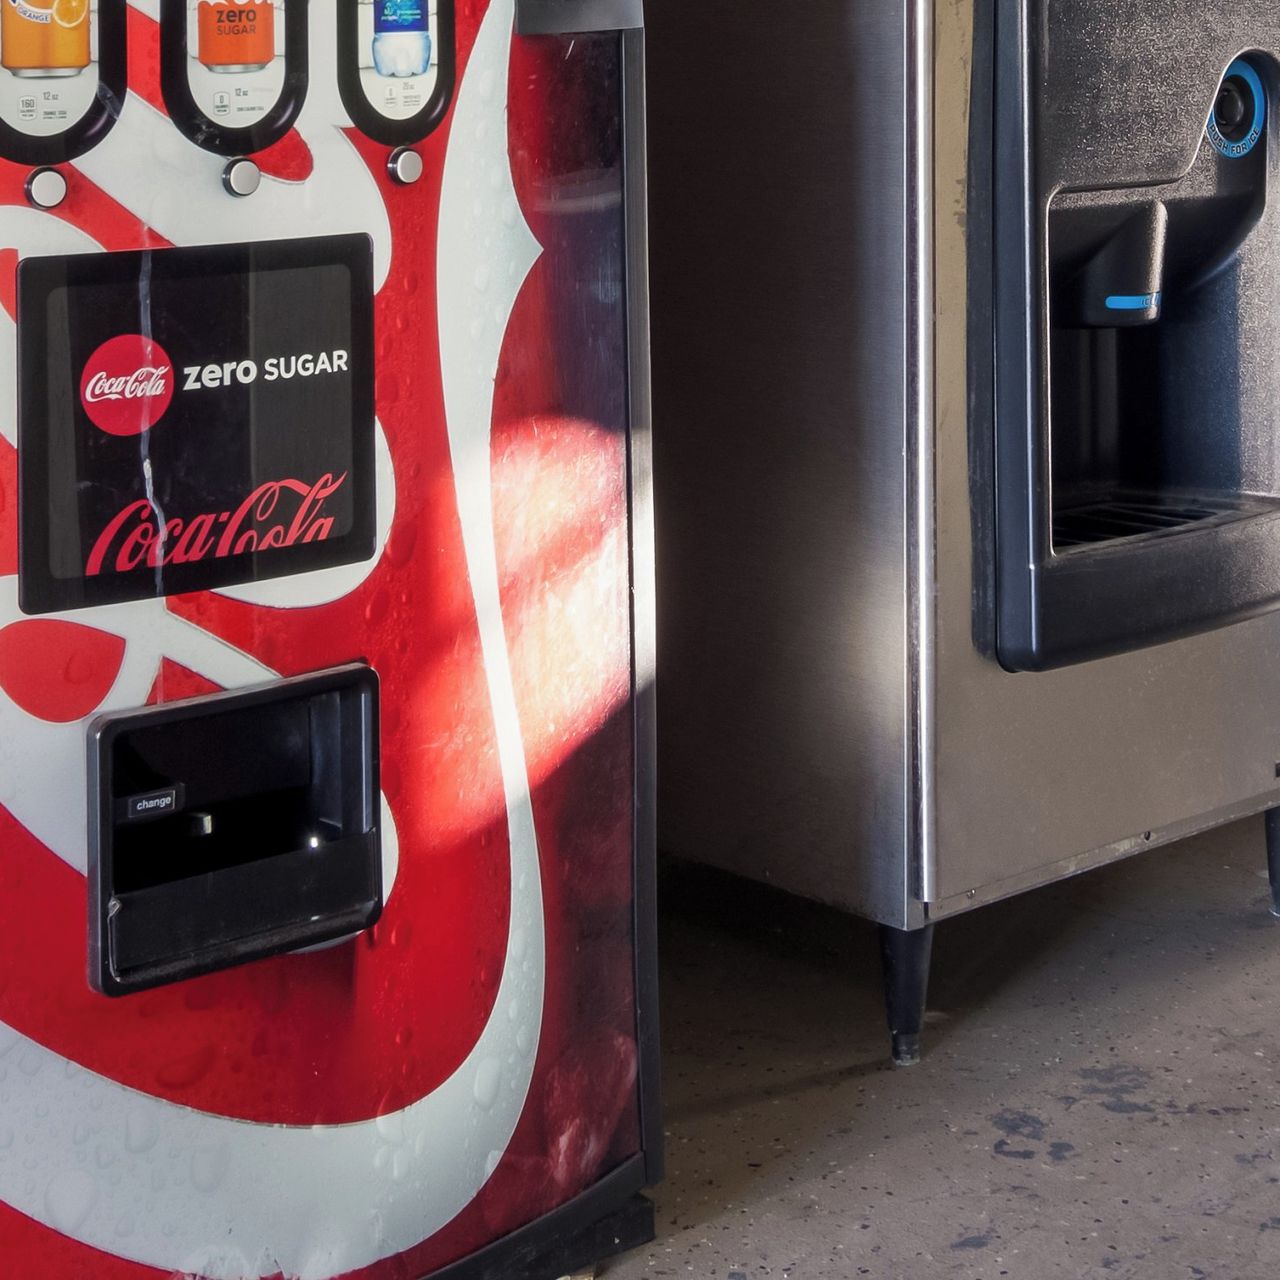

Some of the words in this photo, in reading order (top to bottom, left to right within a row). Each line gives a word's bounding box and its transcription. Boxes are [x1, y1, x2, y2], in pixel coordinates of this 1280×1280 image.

[17, 6, 50, 22] ORANGE
[216, 9, 257, 23] zero
[216, 24, 257, 35] SUGAR
[43, 92, 50, 100] 12
[1209, 122, 1228, 152] PUSH
[1231, 144, 1248, 154] FOR
[1249, 126, 1260, 144] ICE
[85, 366, 169, 402] Coca-Cola
[183, 360, 258, 391] zero
[264, 350, 348, 381] SUGAR
[137, 795, 172, 810] change
